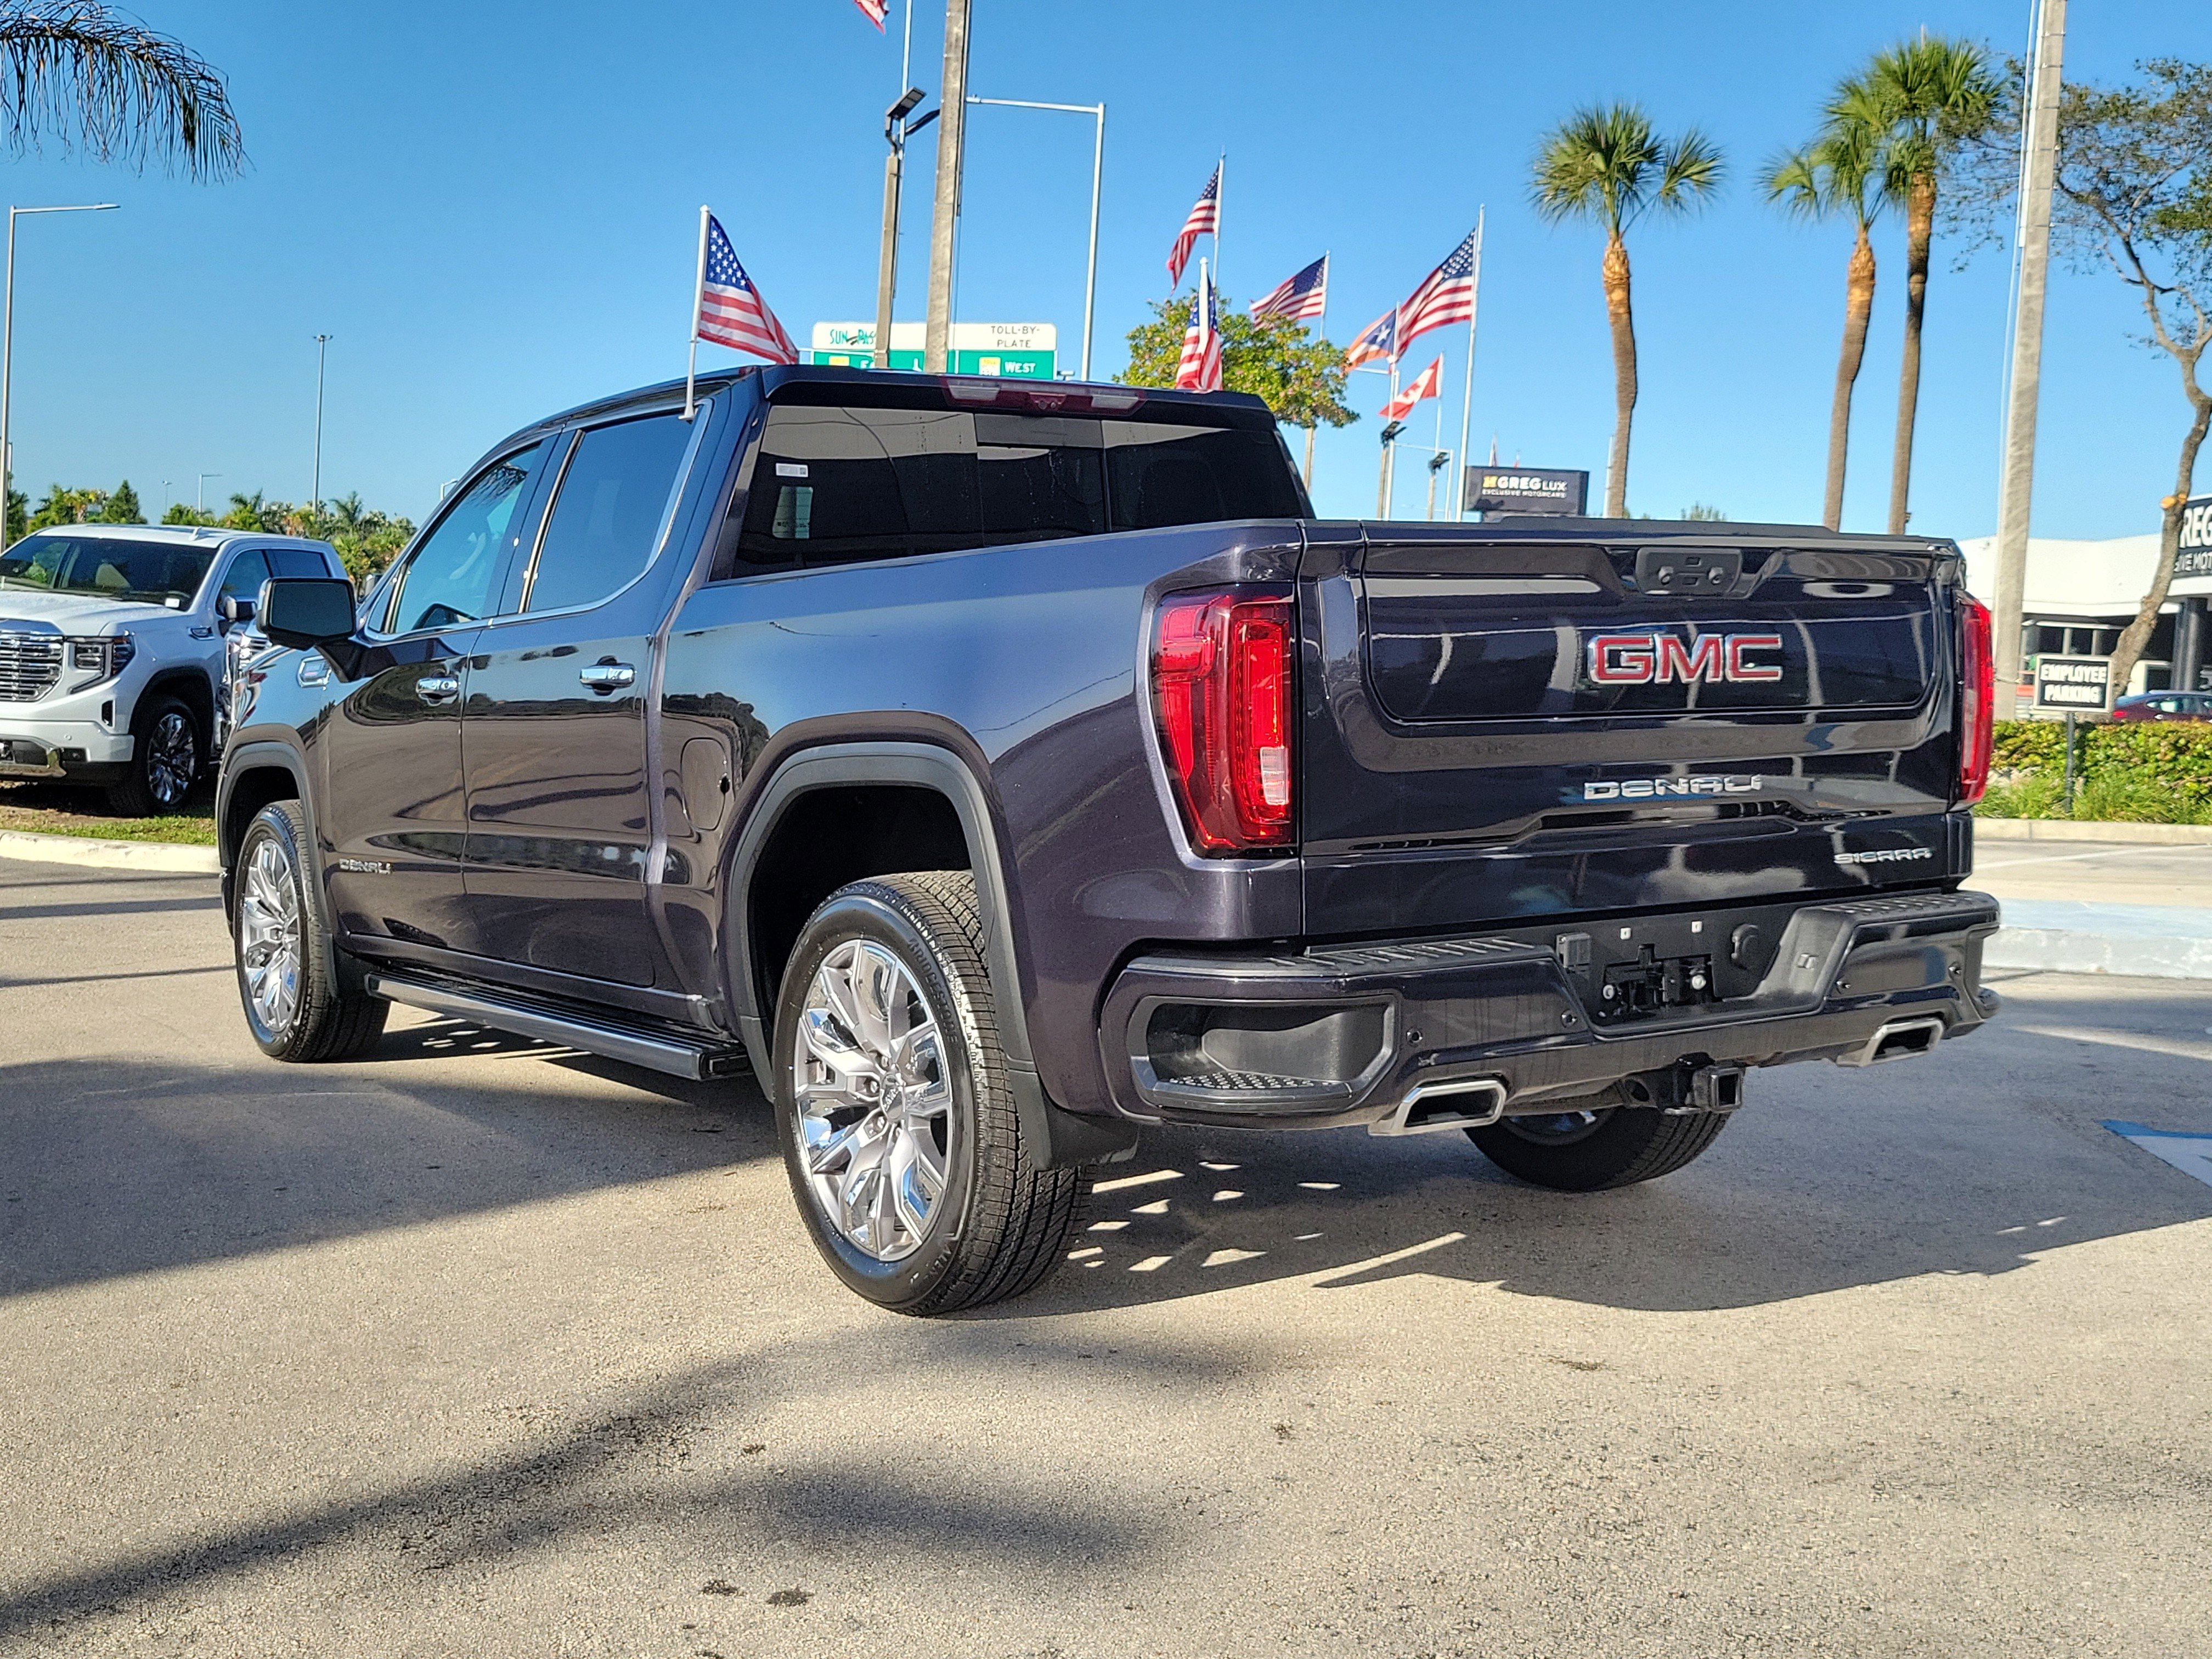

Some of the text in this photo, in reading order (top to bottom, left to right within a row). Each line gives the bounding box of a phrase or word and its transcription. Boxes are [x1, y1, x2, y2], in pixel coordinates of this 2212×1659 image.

[997, 339, 1032, 348] PLATE
[1005, 361, 1036, 373] WEST
[1587, 633, 1783, 684] GMC
[2040, 663, 2107, 684] EMPLOYEE
[2044, 684, 2102, 704] PARKING
[1584, 774, 1763, 800] DENALI
[1833, 847, 1933, 865] SIERRA
[339, 857, 391, 875] DENALI
